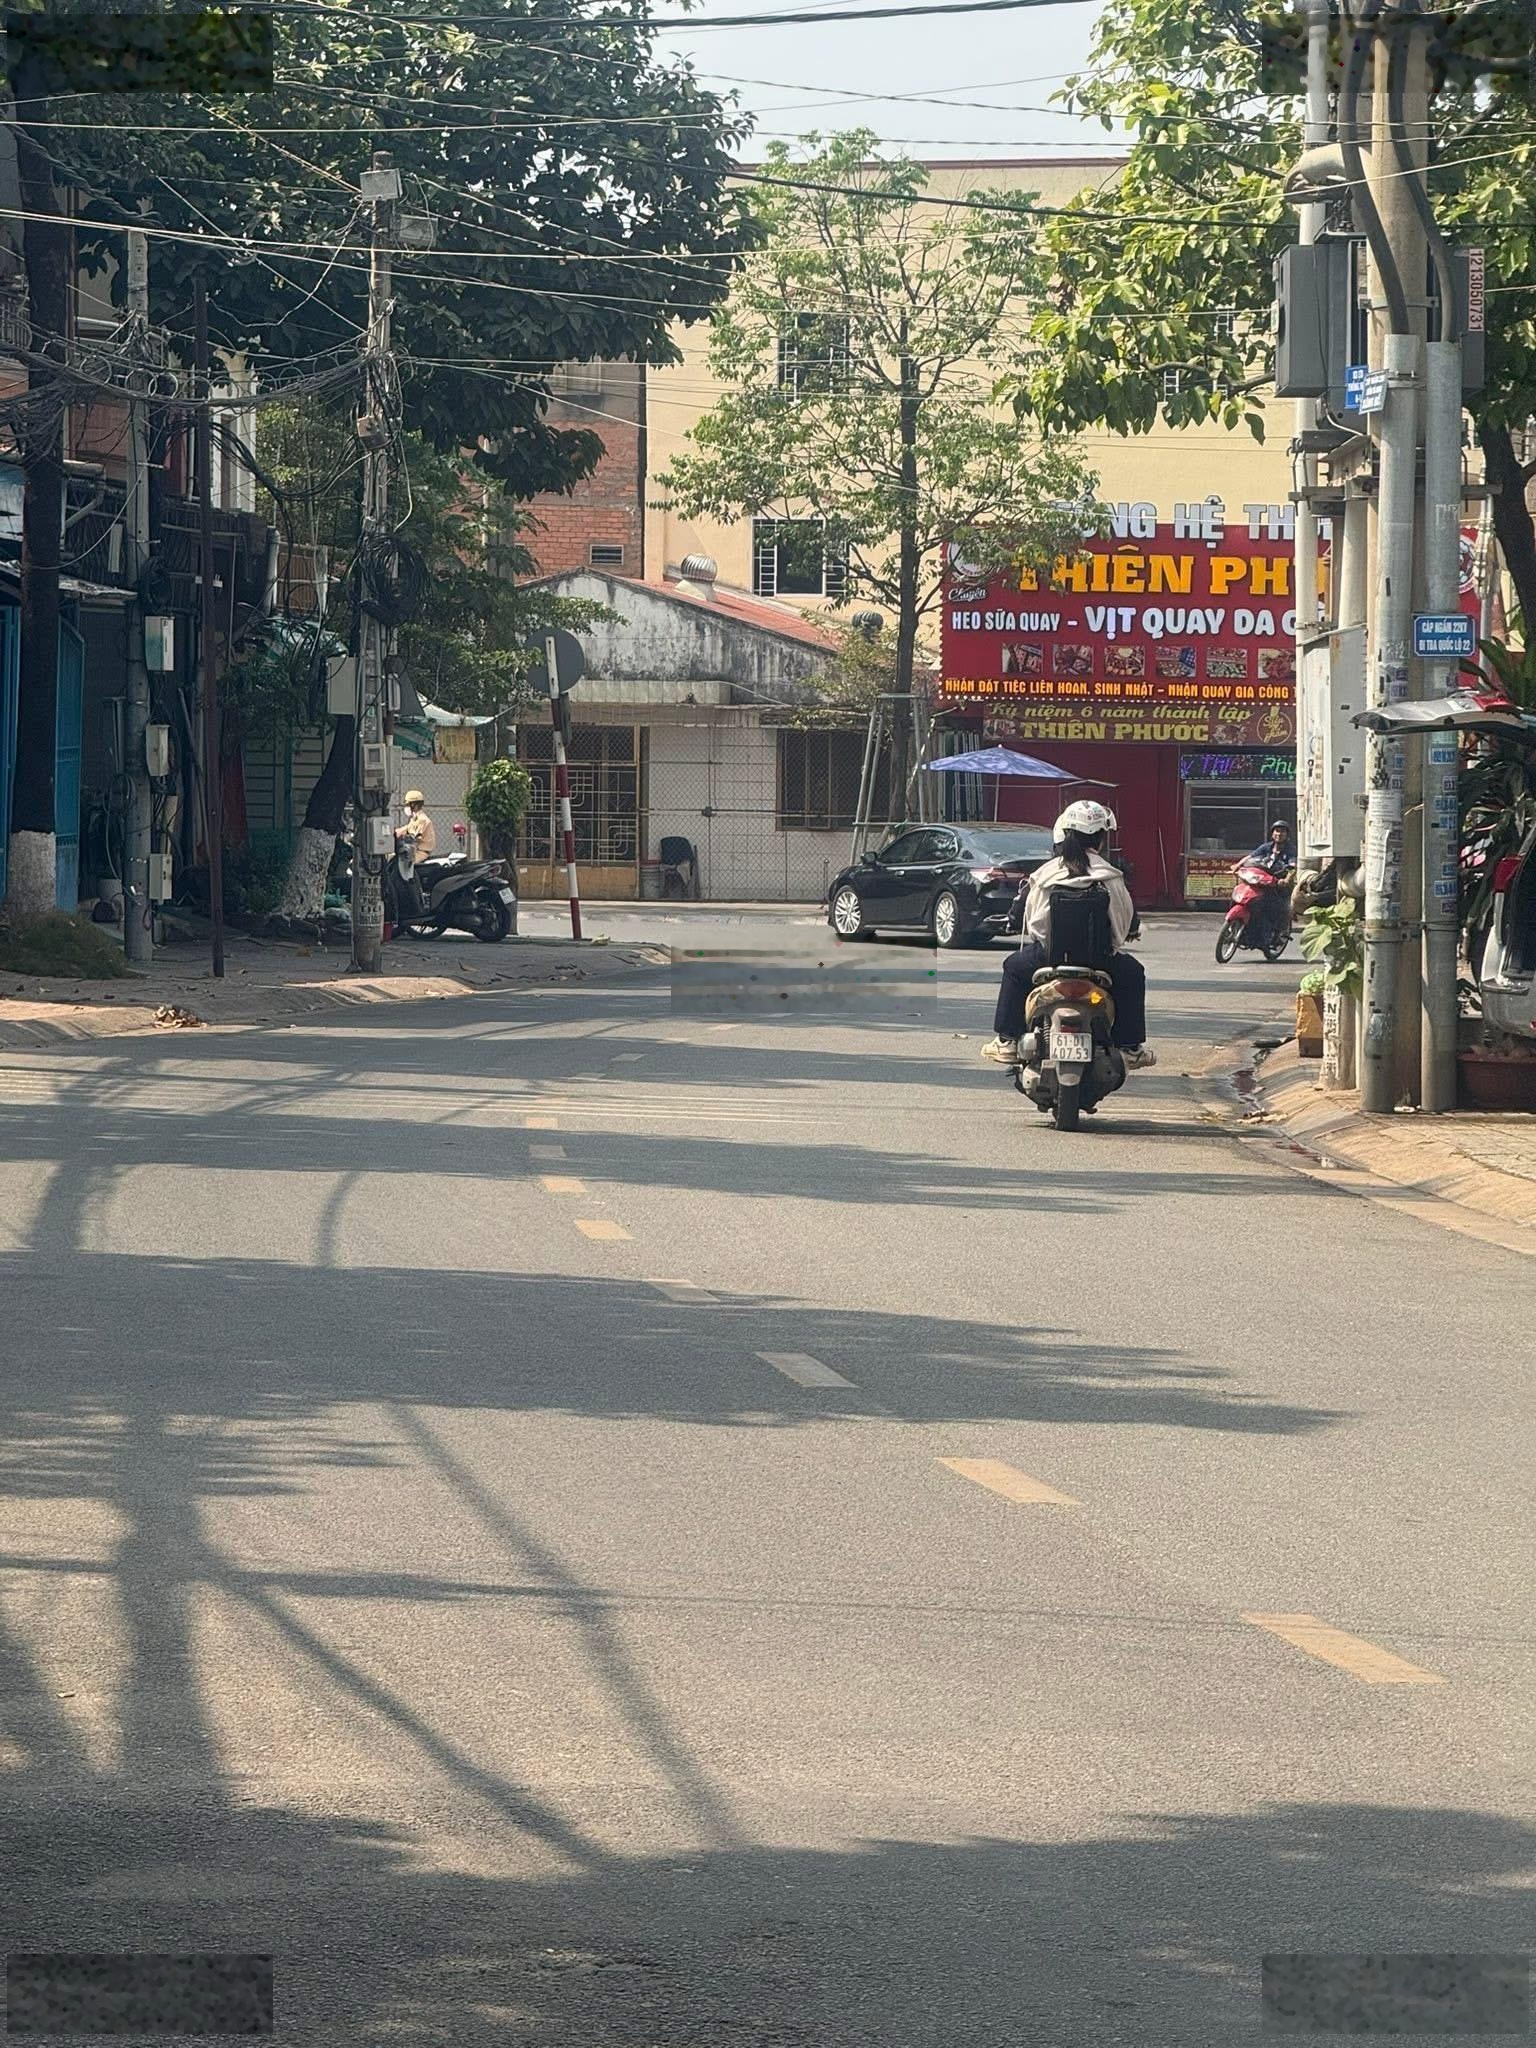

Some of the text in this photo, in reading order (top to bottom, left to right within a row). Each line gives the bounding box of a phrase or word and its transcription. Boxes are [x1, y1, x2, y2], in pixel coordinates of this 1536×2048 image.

[1470, 252, 1484, 330] 1213050731
[1174, 495, 1225, 548] HỆ
[952, 611, 981, 630] HEO
[985, 608, 1016, 631] SỮA
[1019, 612, 1061, 632] QUAY
[1084, 606, 1137, 640] VỊT
[1142, 607, 1225, 639] QUAY
[1234, 609, 1275, 636] DA
[1095, 682, 1121, 695] SINH
[1168, 682, 1198, 699] NHẬN
[1202, 685, 1231, 698] QUAY
[1235, 686, 1254, 698] GIA
[1258, 684, 1289, 698] CÔNG
[1024, 704, 1073, 720] niệm
[1081, 706, 1093, 718] 6
[1100, 706, 1145, 718] năm
[1152, 705, 1210, 720] thành
[1218, 706, 1253, 723] lập
[1020, 719, 1209, 741] THIÊN PHƯỚC
